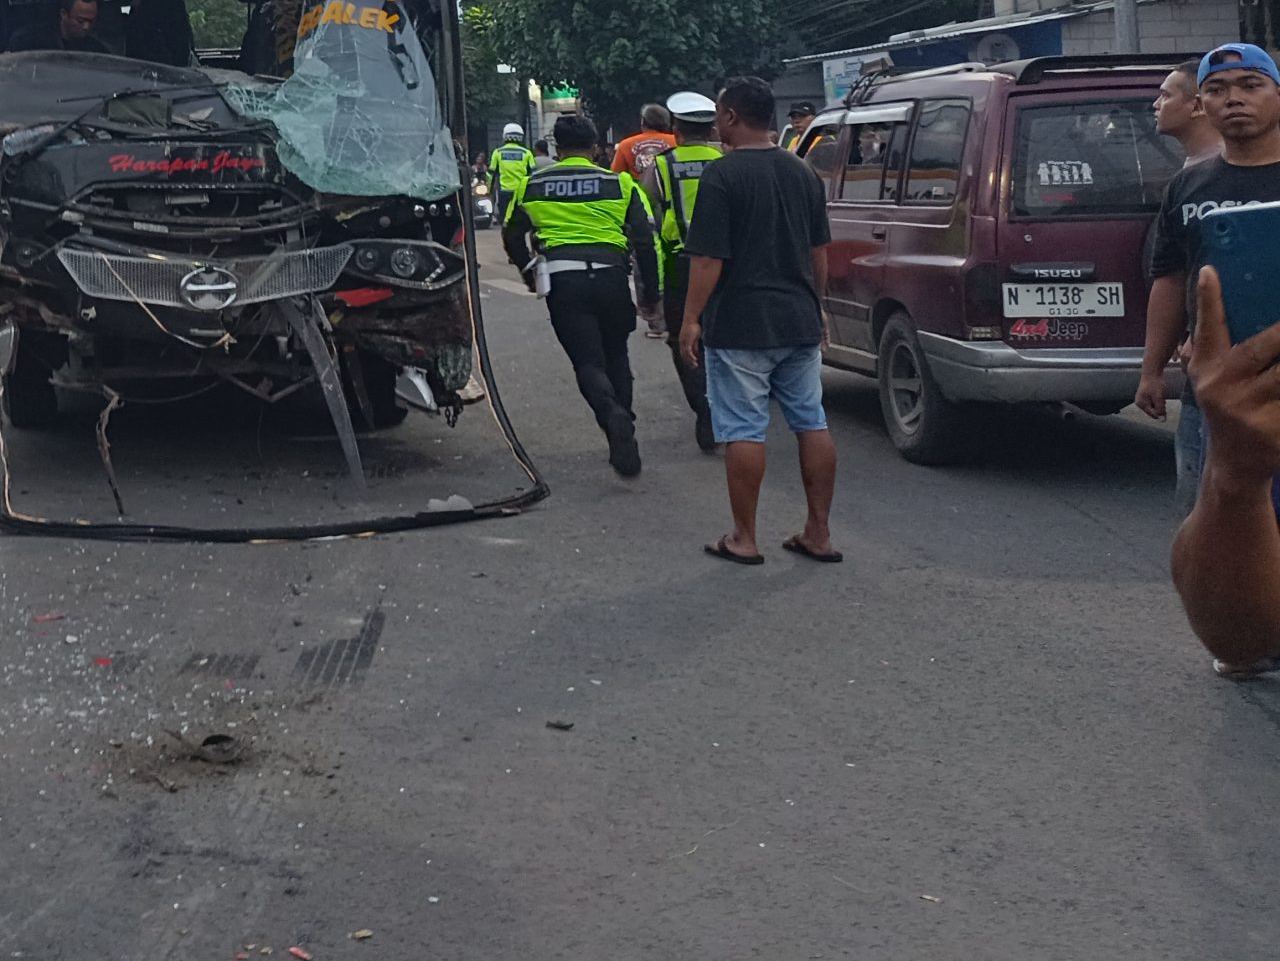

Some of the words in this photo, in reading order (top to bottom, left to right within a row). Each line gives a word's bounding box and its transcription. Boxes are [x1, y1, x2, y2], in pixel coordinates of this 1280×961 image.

[108, 154, 208, 175] Harapan
[545, 180, 599, 196] POLISI
[1035, 269, 1081, 278] ISUZU
[1007, 287, 1019, 305] N
[1035, 286, 1081, 305] 1138
[1097, 286, 1120, 305] SH
[1009, 319, 1049, 336] 4x4
[1048, 319, 1088, 340] Jeep
